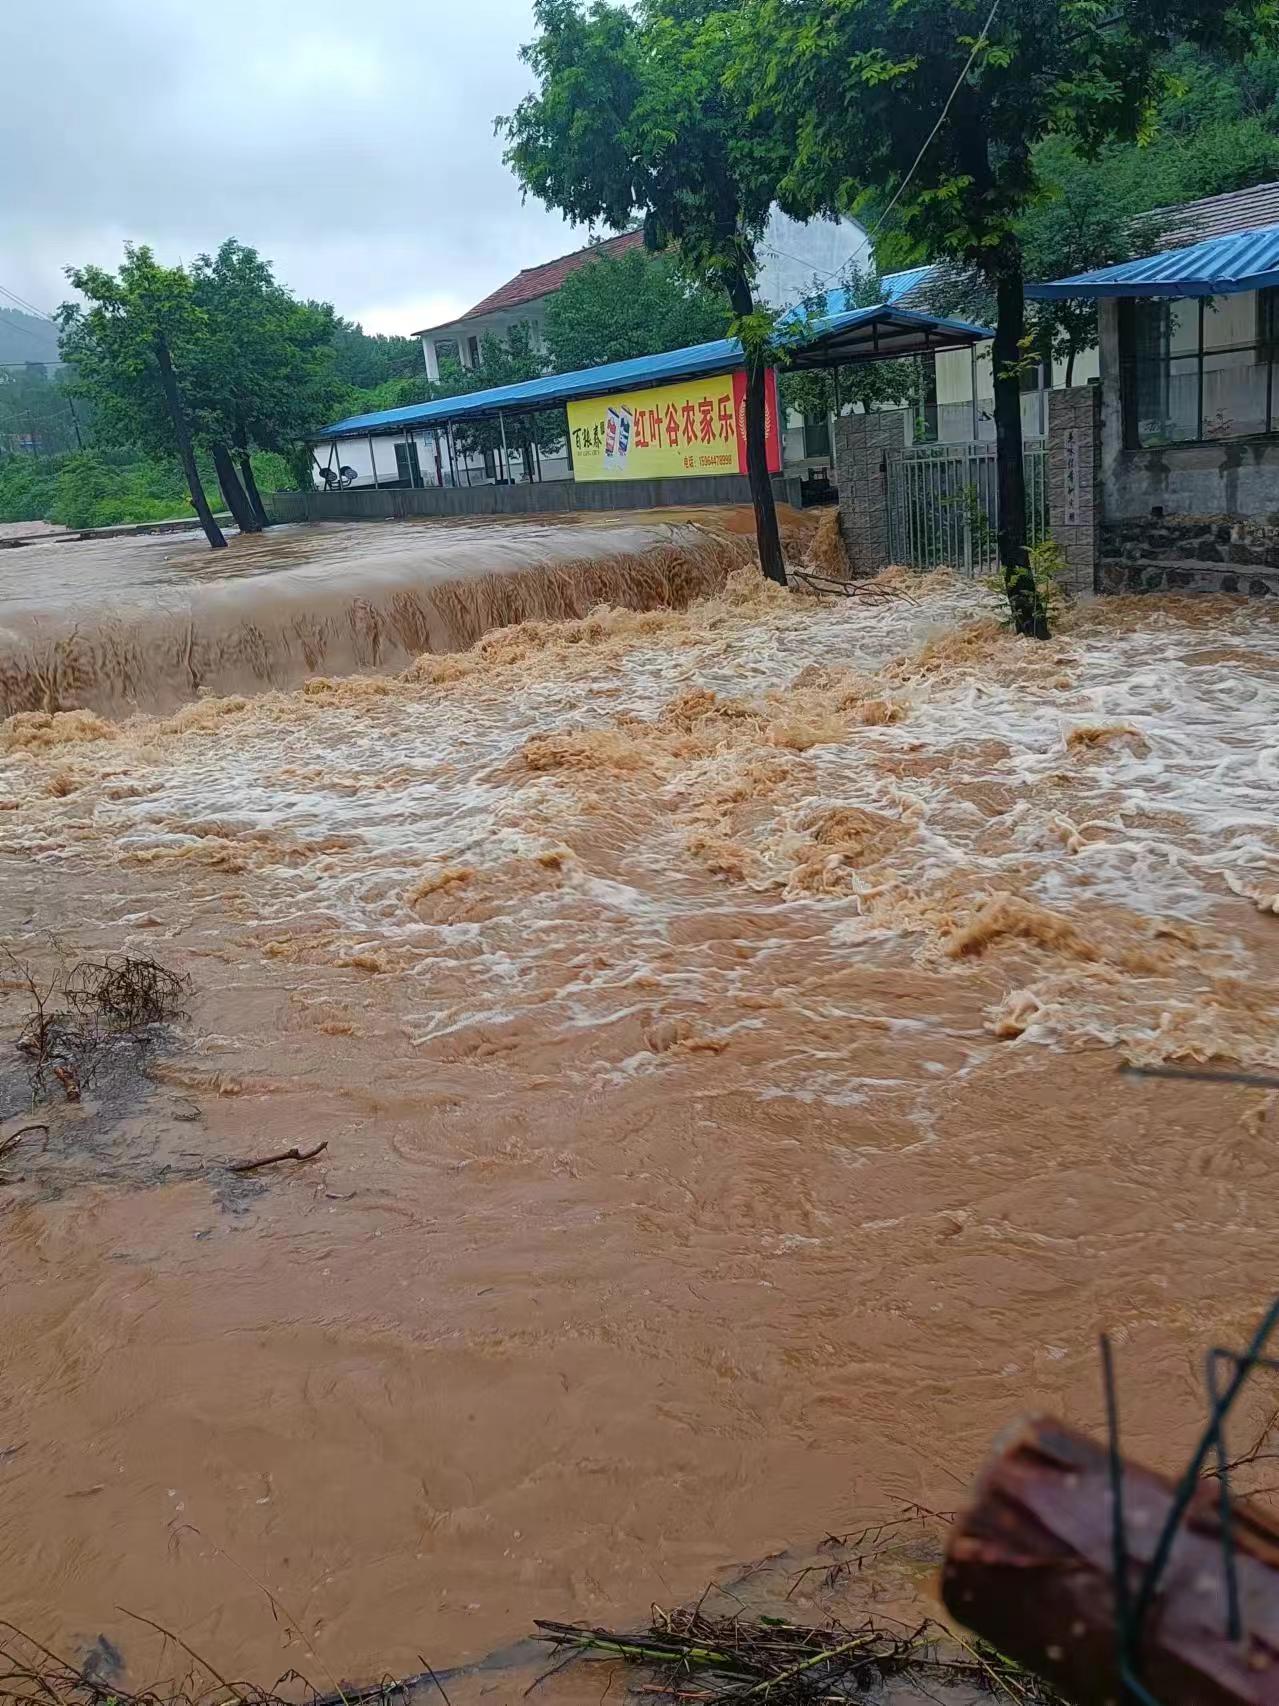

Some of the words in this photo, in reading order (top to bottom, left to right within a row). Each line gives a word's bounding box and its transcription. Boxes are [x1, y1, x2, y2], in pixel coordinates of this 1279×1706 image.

[634, 394, 735, 448] 红叶谷农家乐
